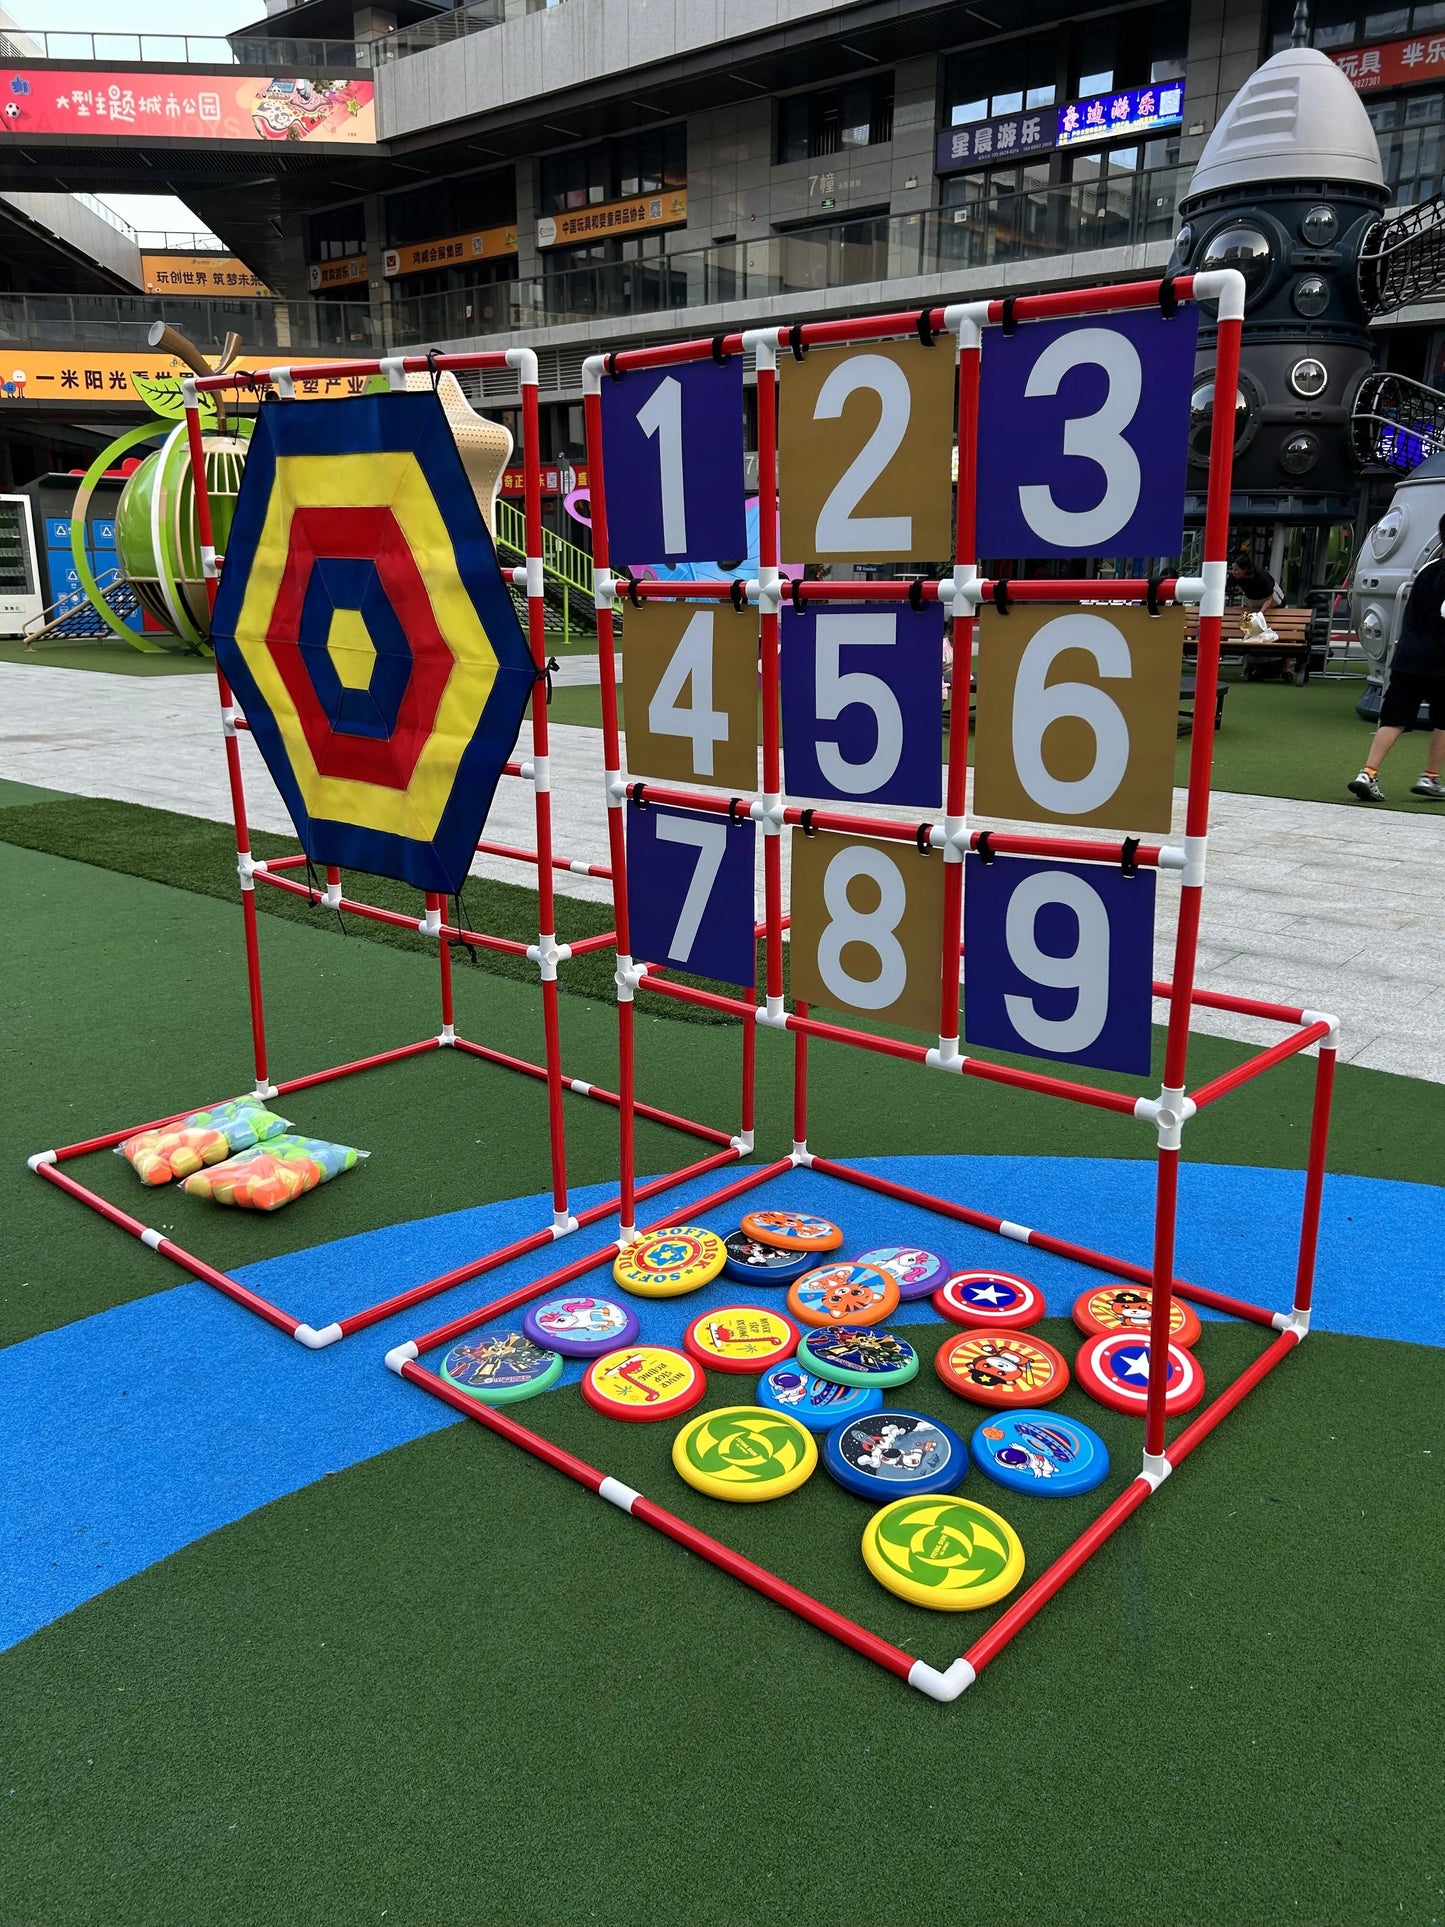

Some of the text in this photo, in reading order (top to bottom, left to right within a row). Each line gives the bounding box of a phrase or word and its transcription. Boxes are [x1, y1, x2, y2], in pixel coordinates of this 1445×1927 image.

[1334, 51, 1381, 78] 玩具
[56, 84, 221, 122] 大型主题城市公园
[1062, 91, 1155, 131] 豪迪游乐
[951, 117, 1040, 158] 星晨游乐
[562, 205, 645, 235] 中国玩具和婴童用品协会
[412, 243, 463, 265] 鸿威会展集团
[156, 270, 263, 286] 玩创世界 筑梦未来
[635, 327, 1142, 554] 1 2 3
[504, 473, 545, 488] 奇正乐
[648, 610, 1132, 814] 4 5 6
[655, 813, 1110, 1053] 7 8 9
[619, 1240, 681, 1283] SOFT DISK
[656, 1227, 719, 1269] SOFT DISK
